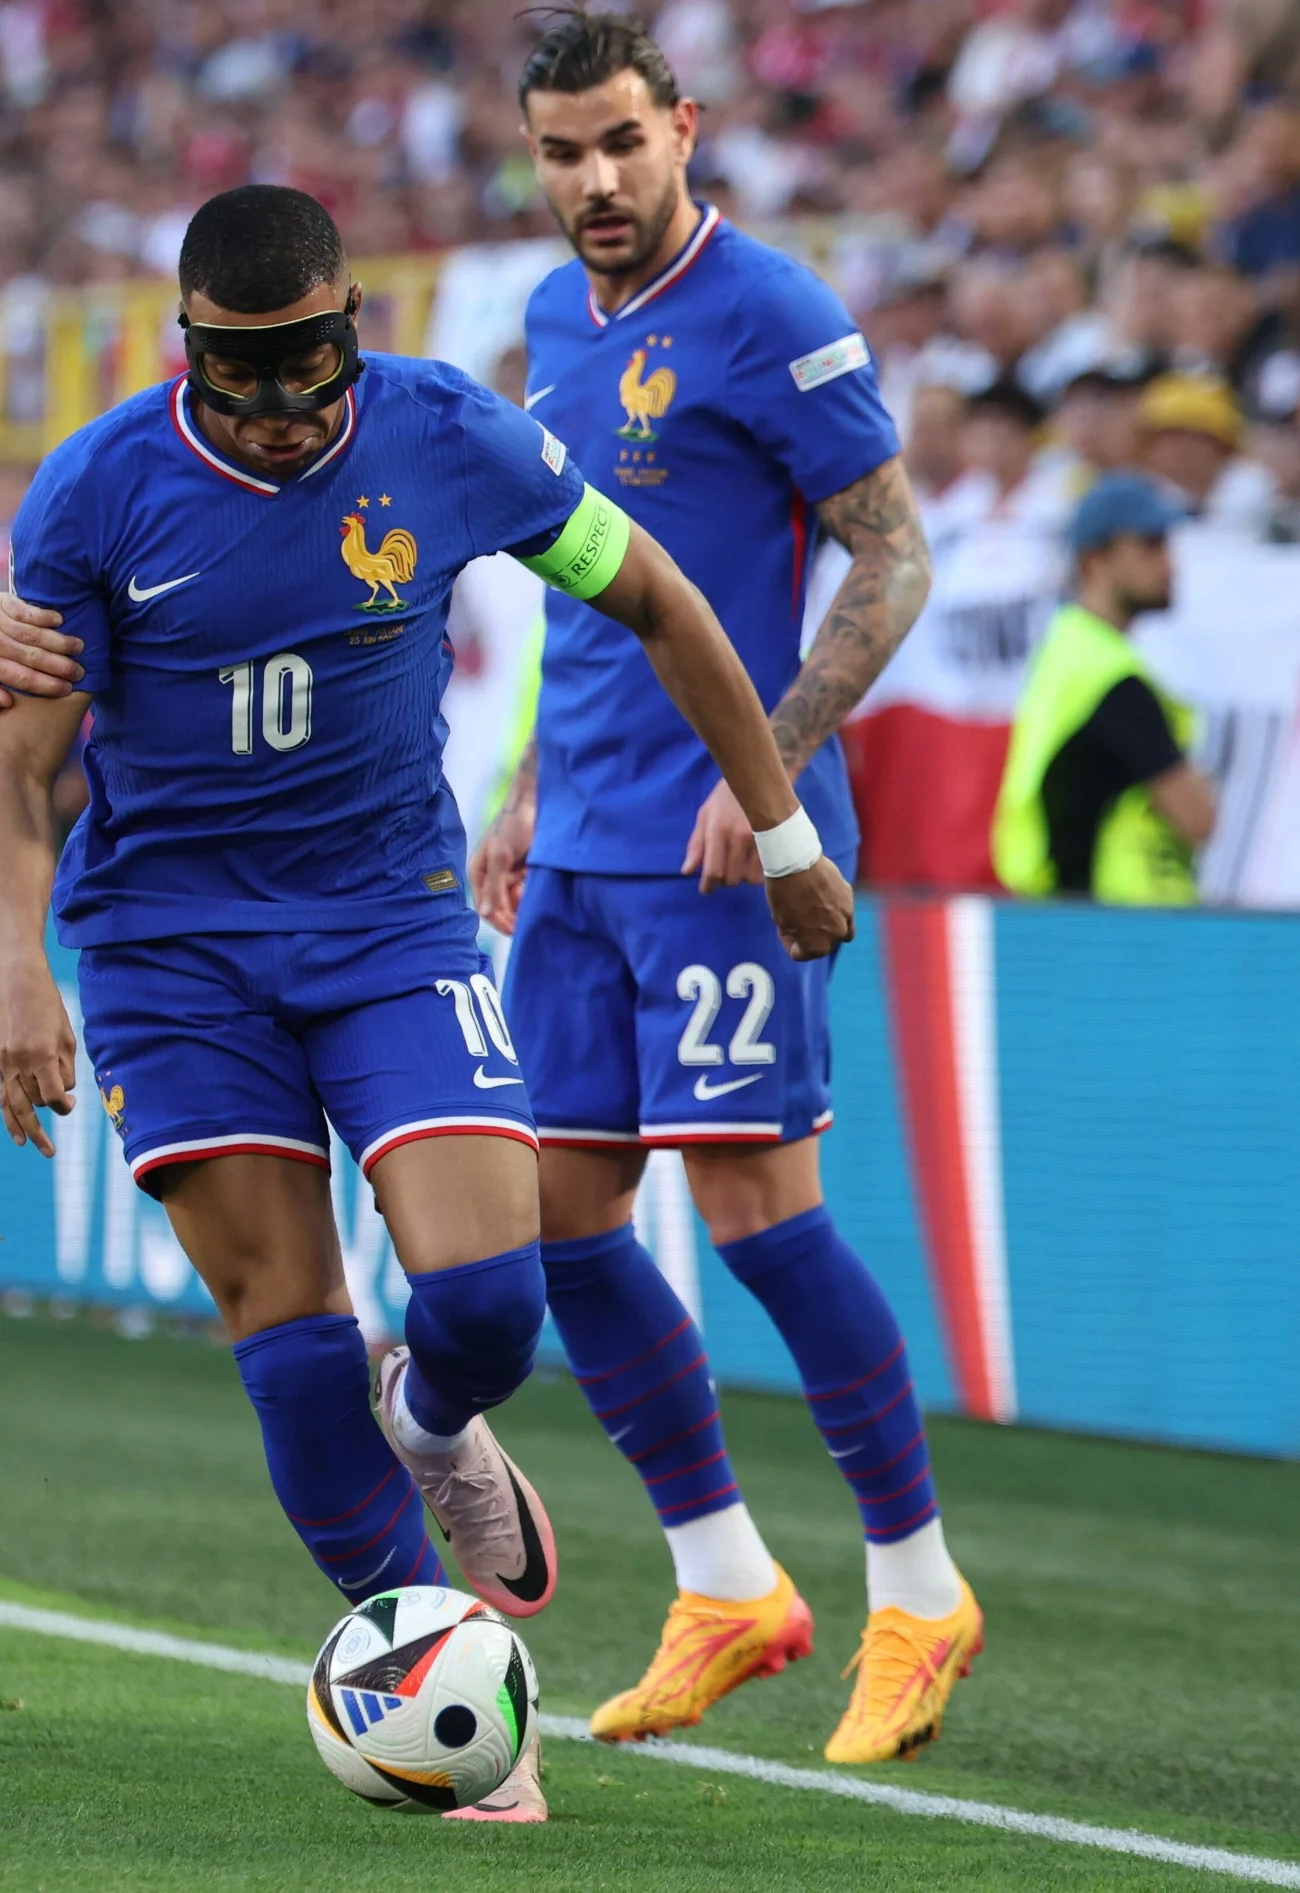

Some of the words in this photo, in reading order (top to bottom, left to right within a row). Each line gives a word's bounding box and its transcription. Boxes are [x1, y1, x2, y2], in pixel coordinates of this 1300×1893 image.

[571, 504, 609, 576] RESPECT
[218, 652, 314, 755] 10
[434, 973, 519, 1066] 10
[676, 961, 777, 1067] 22
